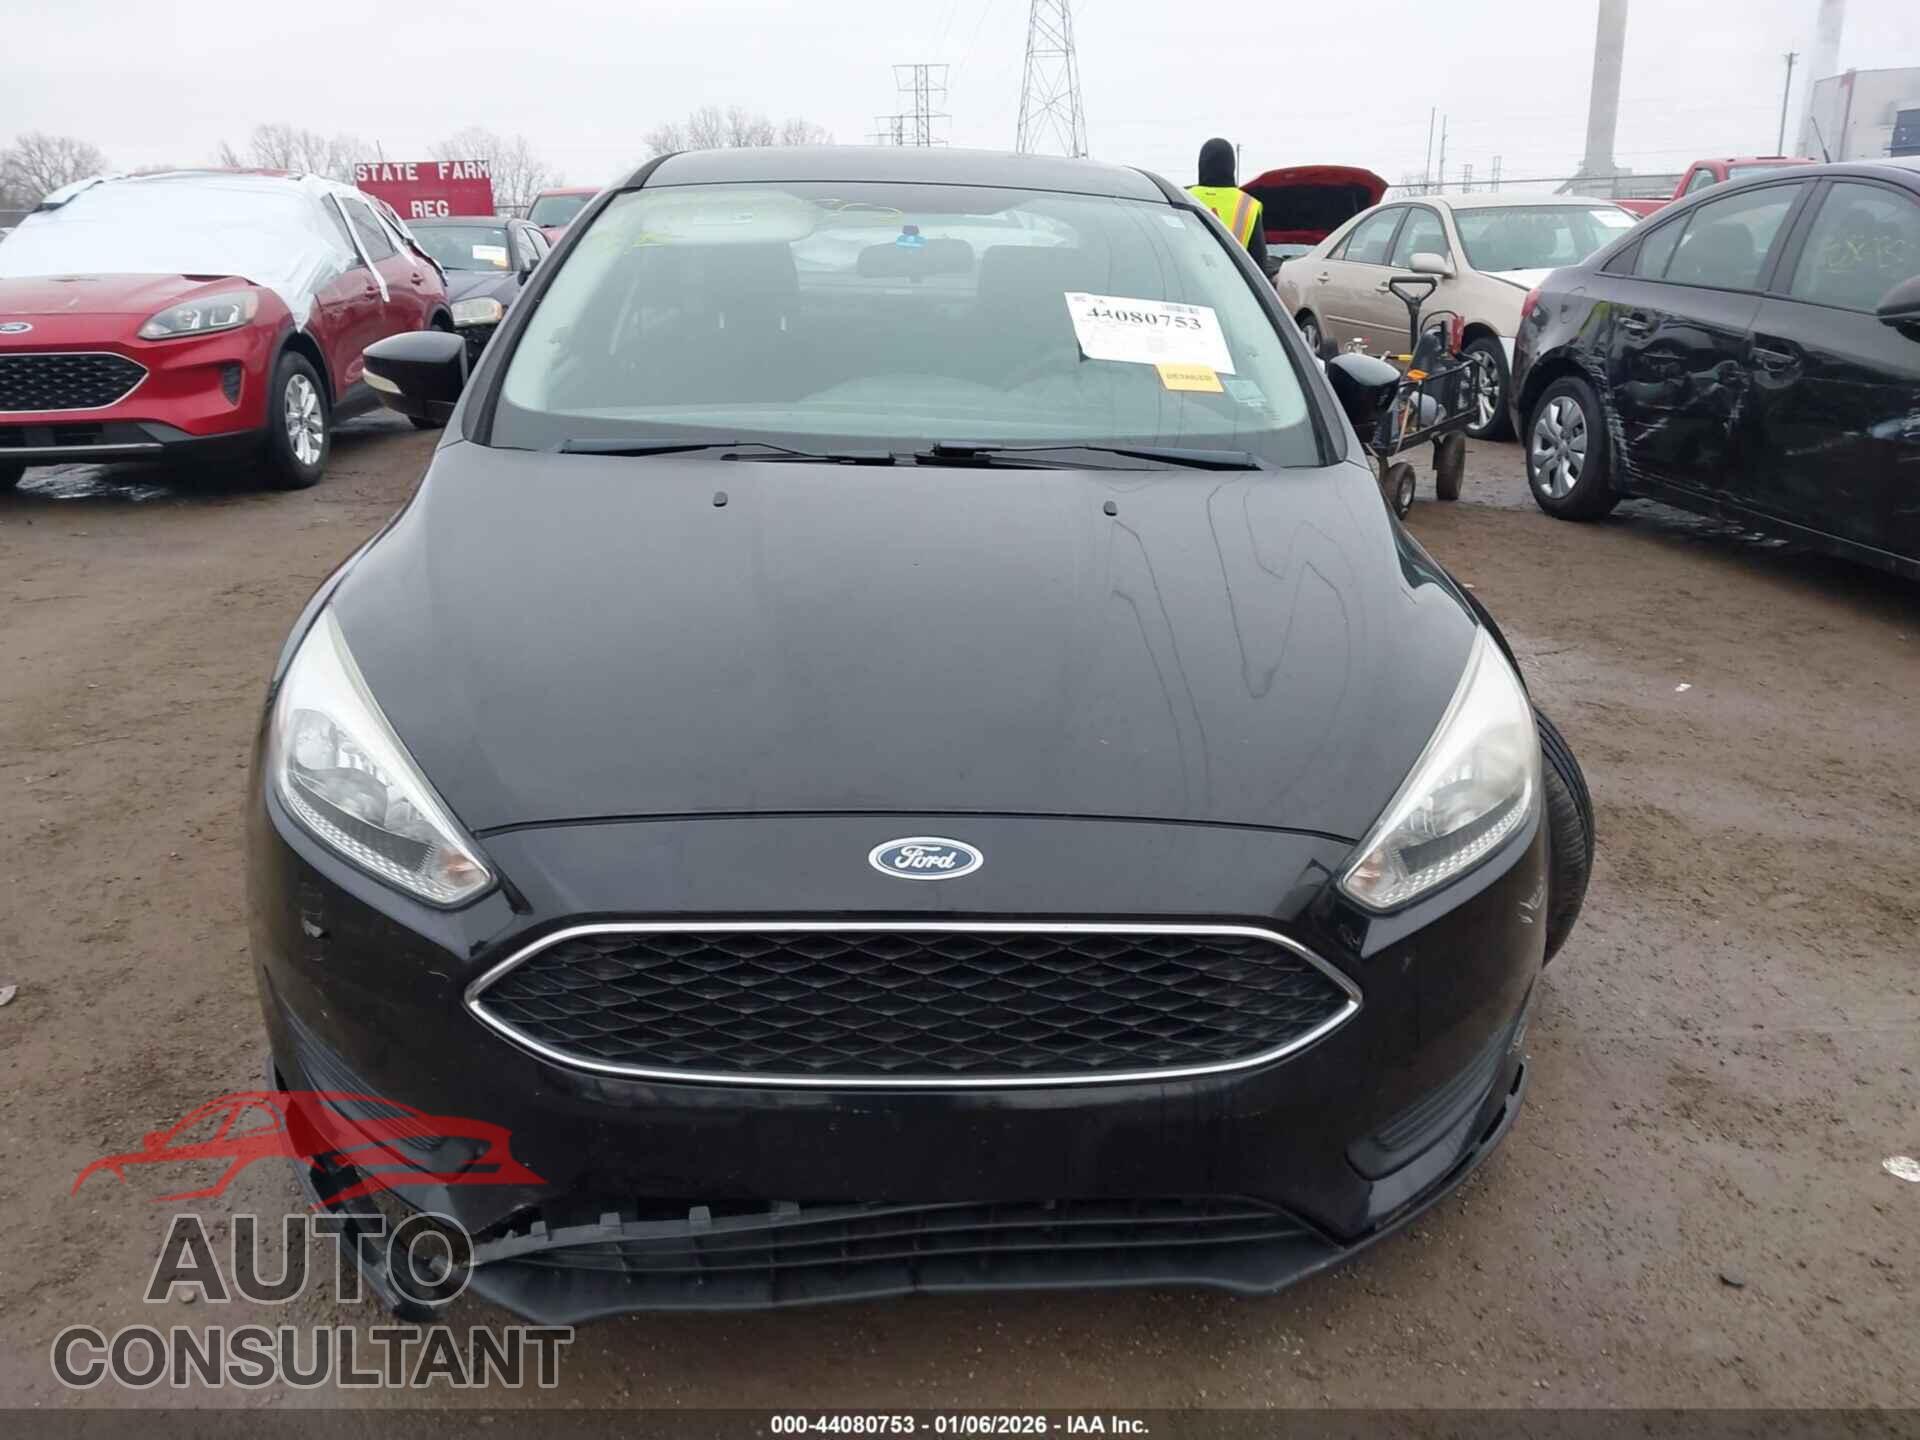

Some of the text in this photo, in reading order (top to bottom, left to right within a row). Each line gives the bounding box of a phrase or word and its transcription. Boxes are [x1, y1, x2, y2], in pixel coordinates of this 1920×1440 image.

[356, 160, 491, 182] STATE FARM
[410, 199, 449, 218] REG
[1086, 307, 1202, 330] 44080753
[894, 845, 957, 869] Ford
